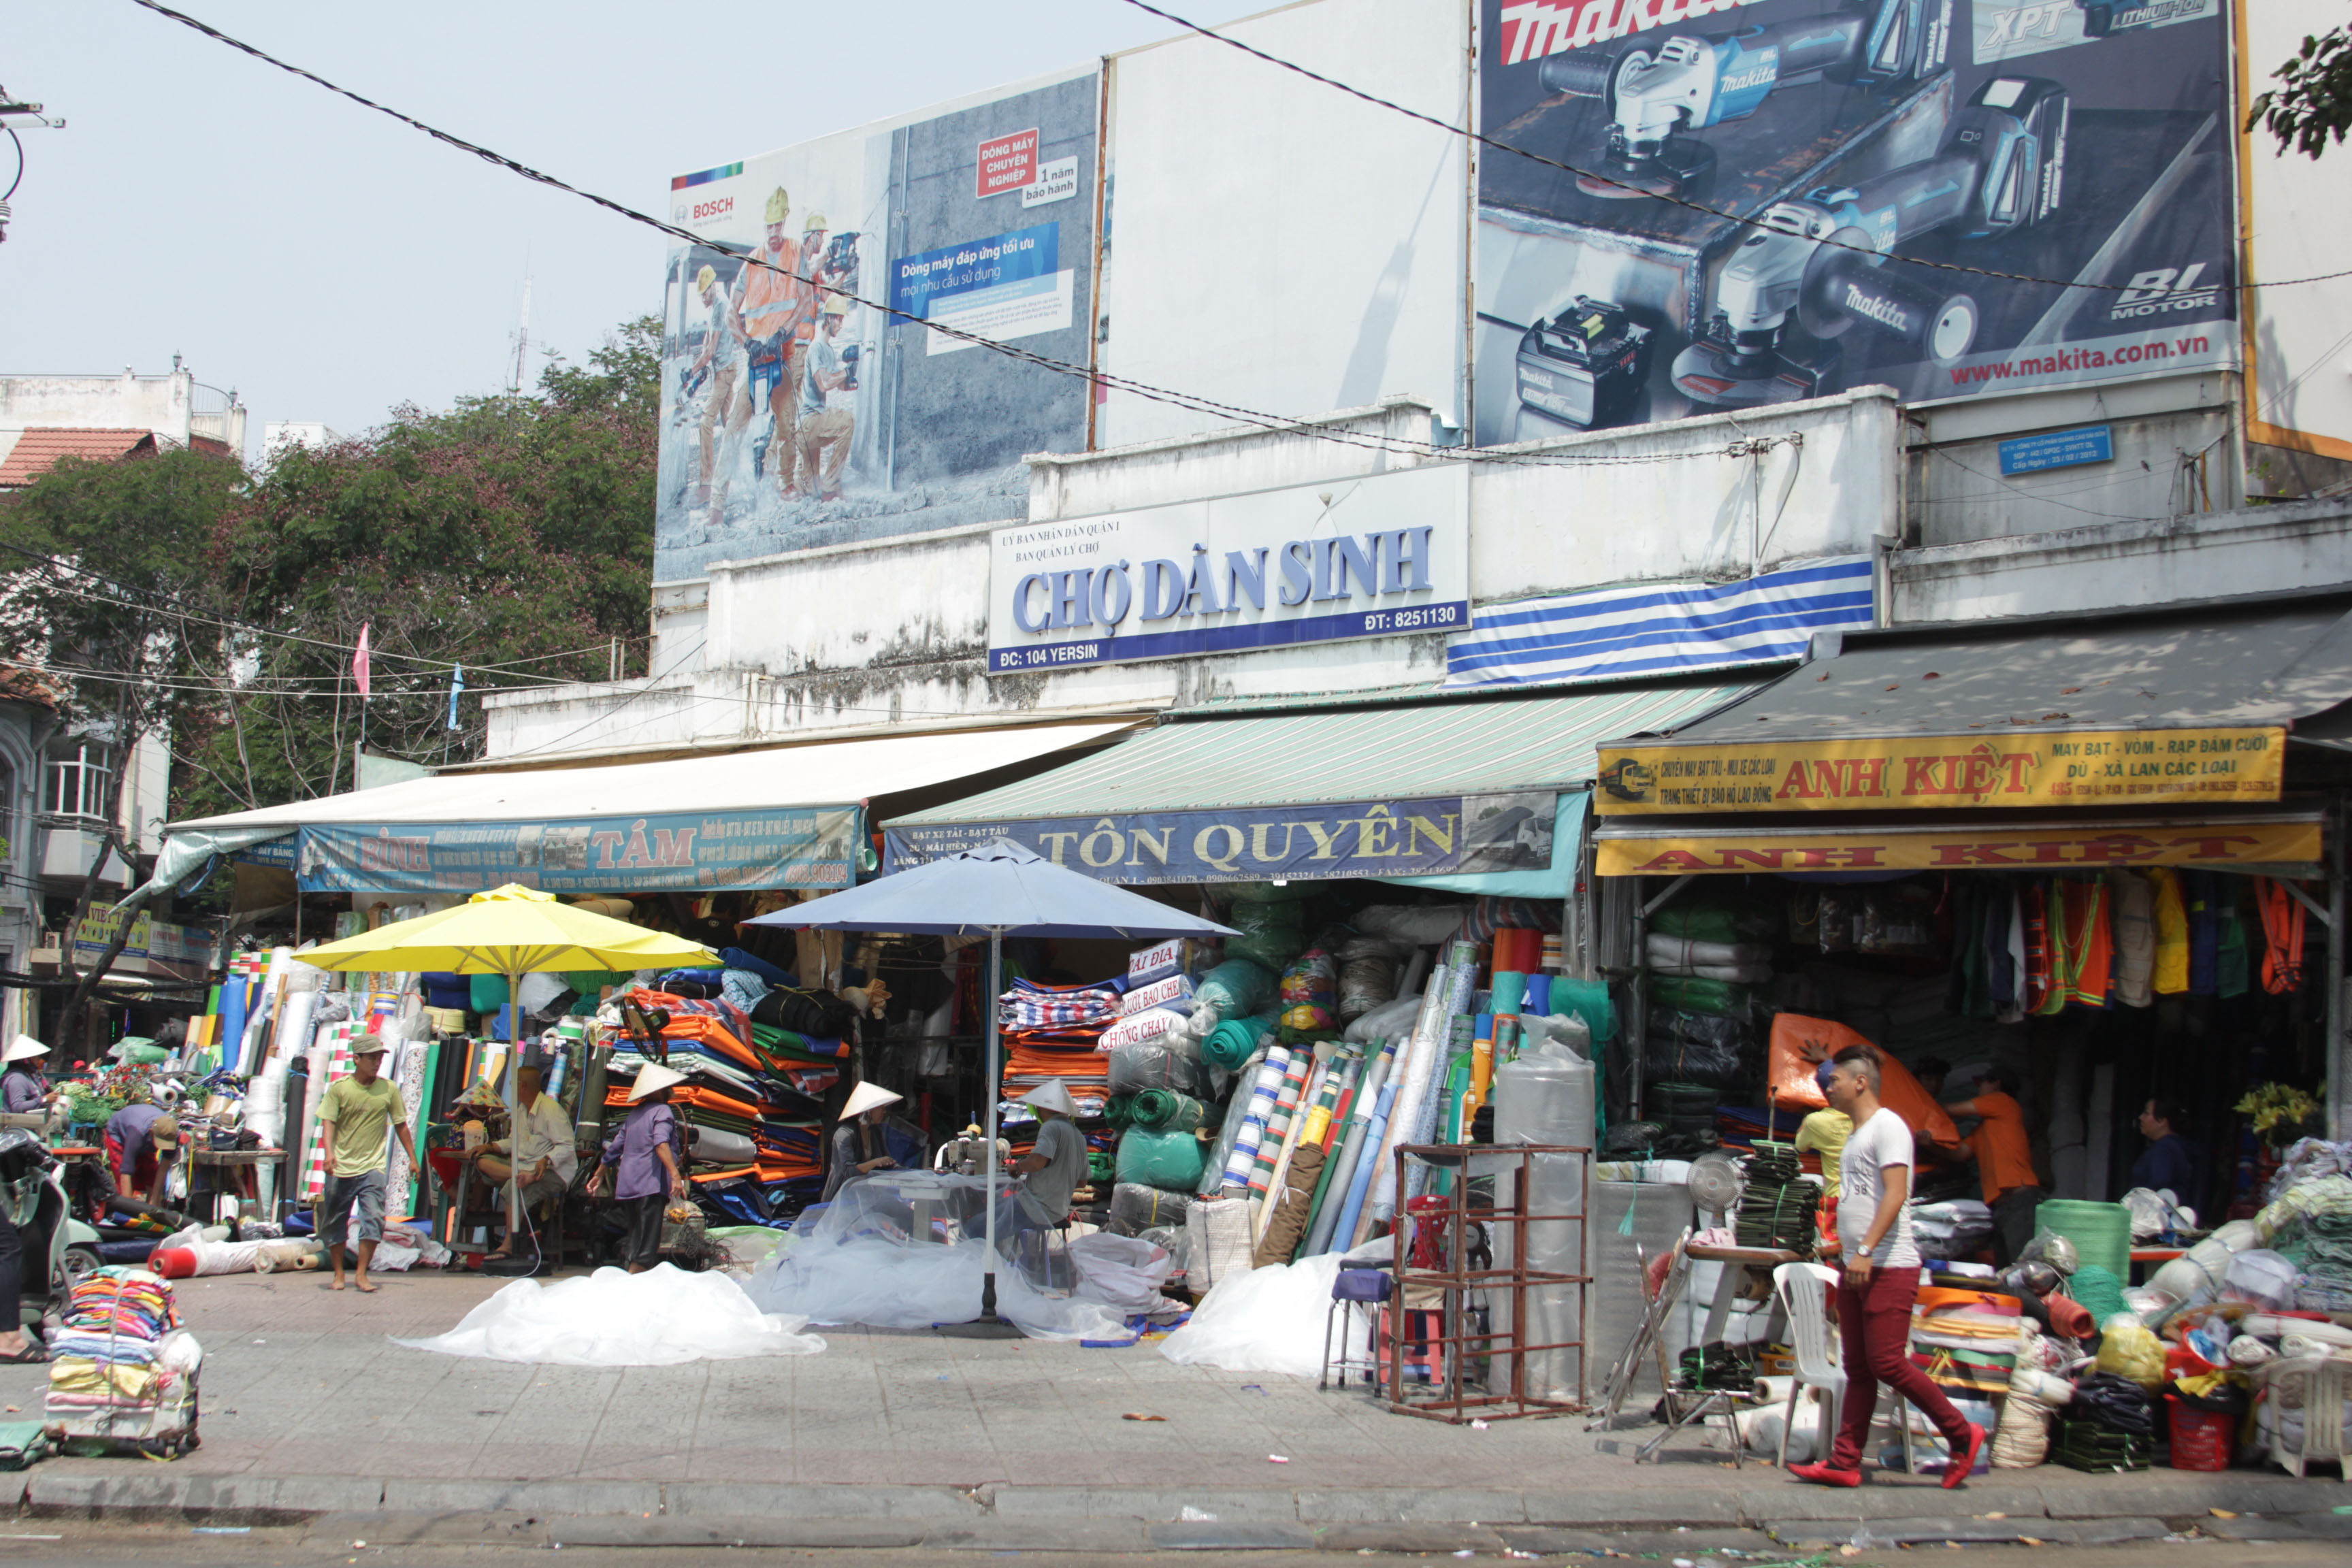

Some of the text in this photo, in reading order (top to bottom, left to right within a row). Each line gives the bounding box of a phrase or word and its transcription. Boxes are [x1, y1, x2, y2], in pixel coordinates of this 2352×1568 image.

[982, 137, 1034, 160] DÒNG MÁY
[987, 154, 1028, 173] CHUYÊN
[1041, 168, 1073, 183] 1 năm
[988, 168, 1026, 188] NGHIỆP
[1026, 180, 1073, 200] bảo hành
[693, 197, 733, 219] BOSCH
[902, 238, 1034, 278] Dòng máy đáp ứng tối ưu
[901, 284, 919, 299] mọi
[921, 280, 941, 293] nhu
[962, 271, 973, 283] sử
[975, 266, 1001, 283] dụng
[2116, 261, 2220, 304] BL
[1846, 283, 1907, 332] Makita
[2111, 295, 2217, 321] MOTOR
[1951, 335, 2209, 385] www.makita.com.vn
[1017, 534, 1037, 545] BAN
[1036, 527, 1065, 542] NHÂN
[1065, 524, 1087, 538] DÂN
[1087, 520, 1114, 537] QUẬN
[1015, 540, 1100, 563] BAN QUẢN LÝ CHỢ
[1013, 525, 1433, 637] CHỢ DÂN SINH
[1365, 606, 1456, 631] ĐT: 8251130
[1000, 644, 1098, 667] ĐC: 104 YERSIN
[2052, 742, 2080, 757] MAY
[2084, 742, 2111, 759] BẠT
[2124, 737, 2155, 755] VÒM
[2168, 739, 2193, 756] RẠP
[1776, 742, 2039, 803] ANH KIỆT
[2067, 760, 2088, 778] DÙ
[2104, 759, 2124, 777] XÀ
[2129, 762, 2160, 777] LAN
[2165, 757, 2197, 775] CÁC
[2201, 759, 2237, 777] LOẠI
[1737, 786, 1751, 804] LAO
[361, 826, 431, 872] BÌNH
[591, 818, 697, 868] TÁM
[913, 826, 1009, 842] BẠT XE TẢI BẠT TÀU
[926, 841, 944, 851] MÁI
[1039, 804, 1460, 872] TÔN QUYÊN
[1635, 832, 2259, 871] ANH KIỆT
[1149, 947, 1173, 967] ĐỊA
[1124, 980, 1179, 1015] LƯỚI BAO CHE
[1100, 1014, 1169, 1049] CHỐNG CHÁY
